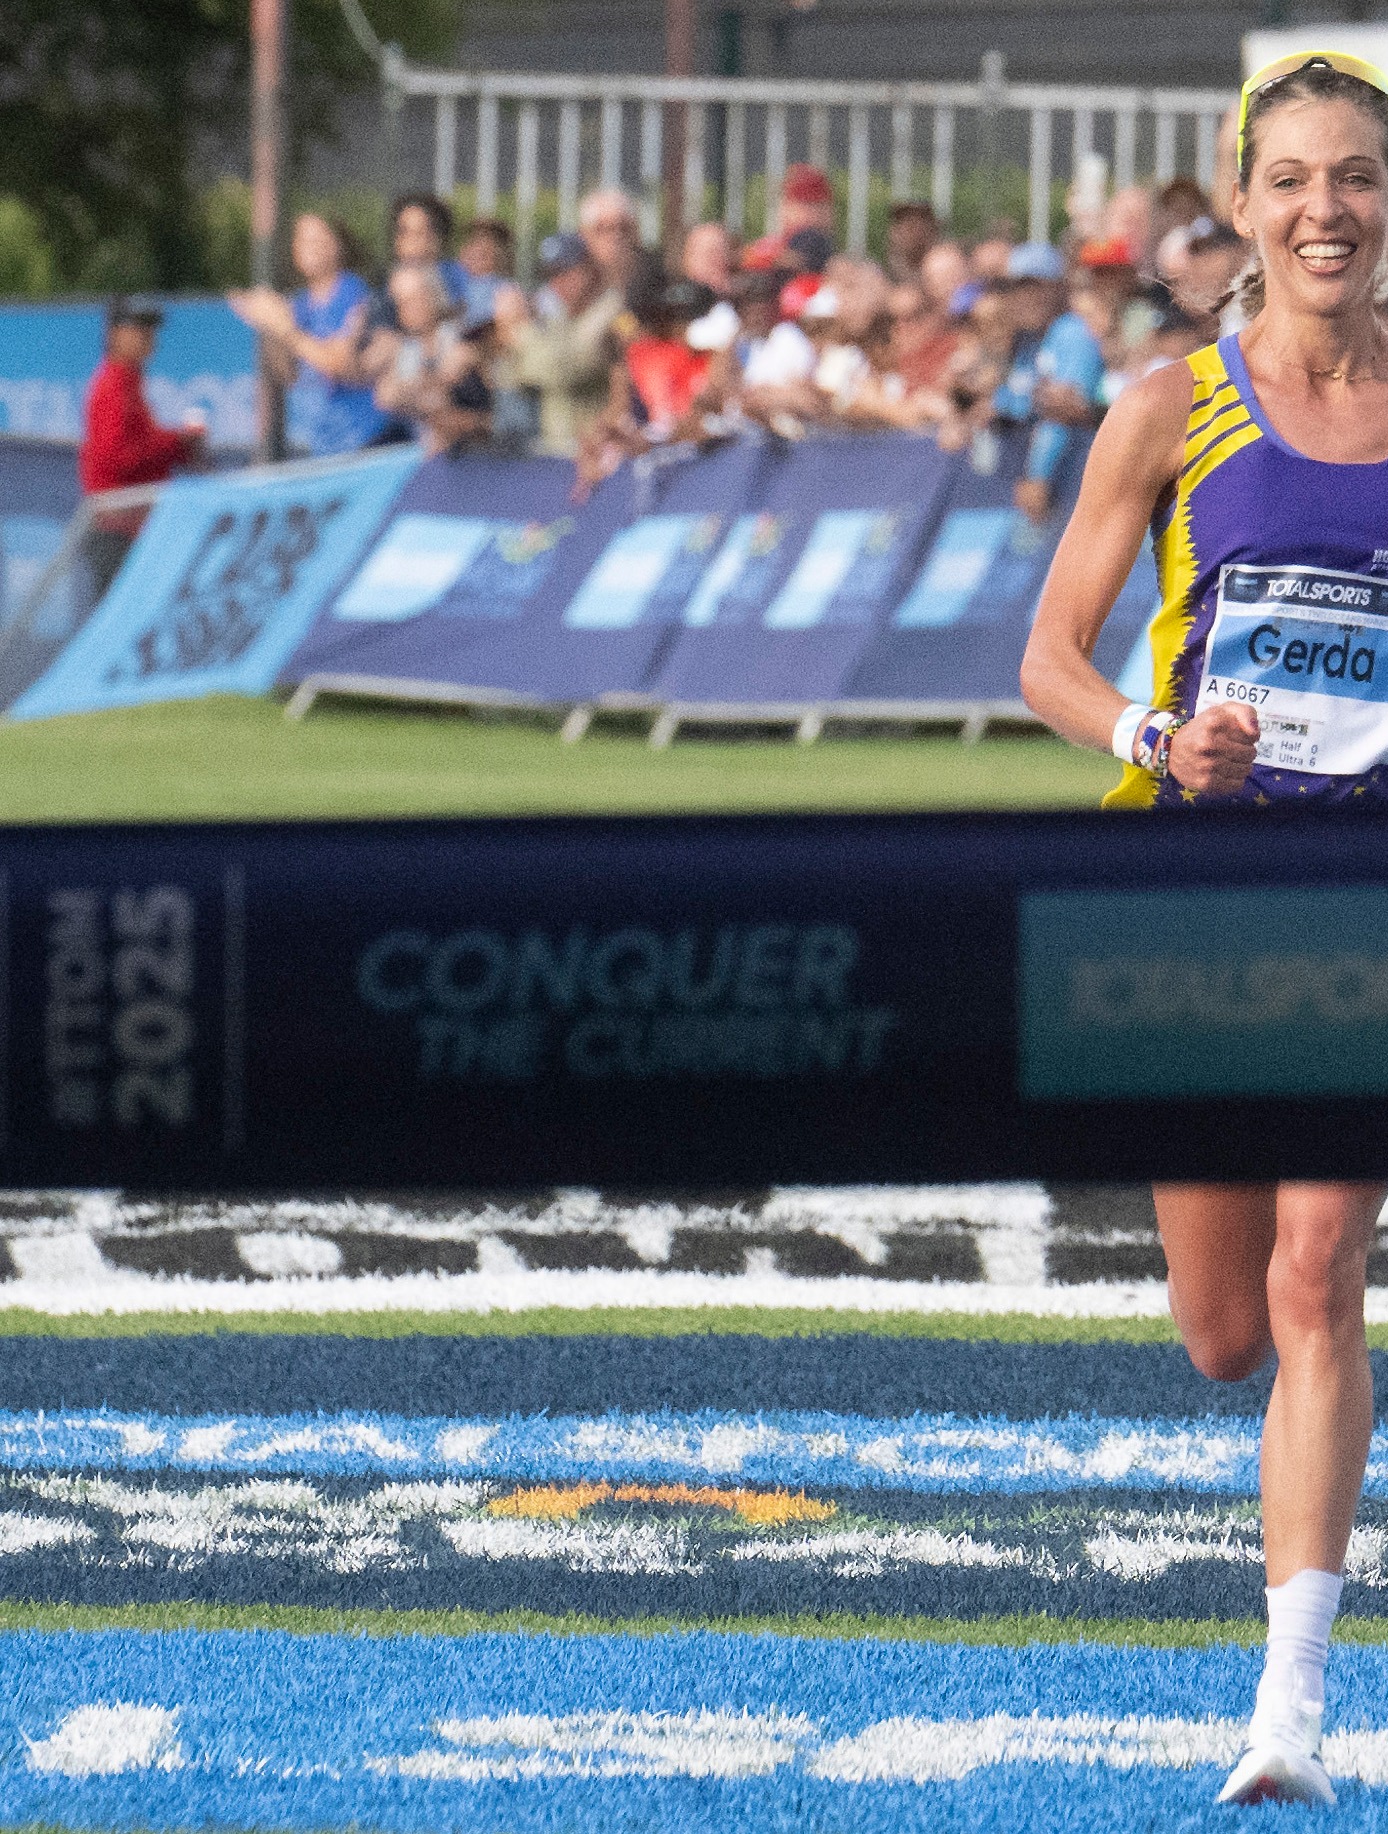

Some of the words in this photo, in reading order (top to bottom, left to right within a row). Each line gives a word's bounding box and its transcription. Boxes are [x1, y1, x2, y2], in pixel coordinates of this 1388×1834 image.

[1266, 578, 1372, 607] TOTALSPORTS
[1248, 624, 1376, 684] Gerda
[1206, 678, 1219, 695] A
[1226, 681, 1270, 705] 6067
[1278, 752, 1304, 766] Ultra
[1280, 740, 1302, 752] Half
[356, 924, 861, 1014] CONQUER
[112, 884, 196, 1126] 2025
[415, 1013, 546, 1080] THE
[565, 1009, 899, 1079] CURRENT
